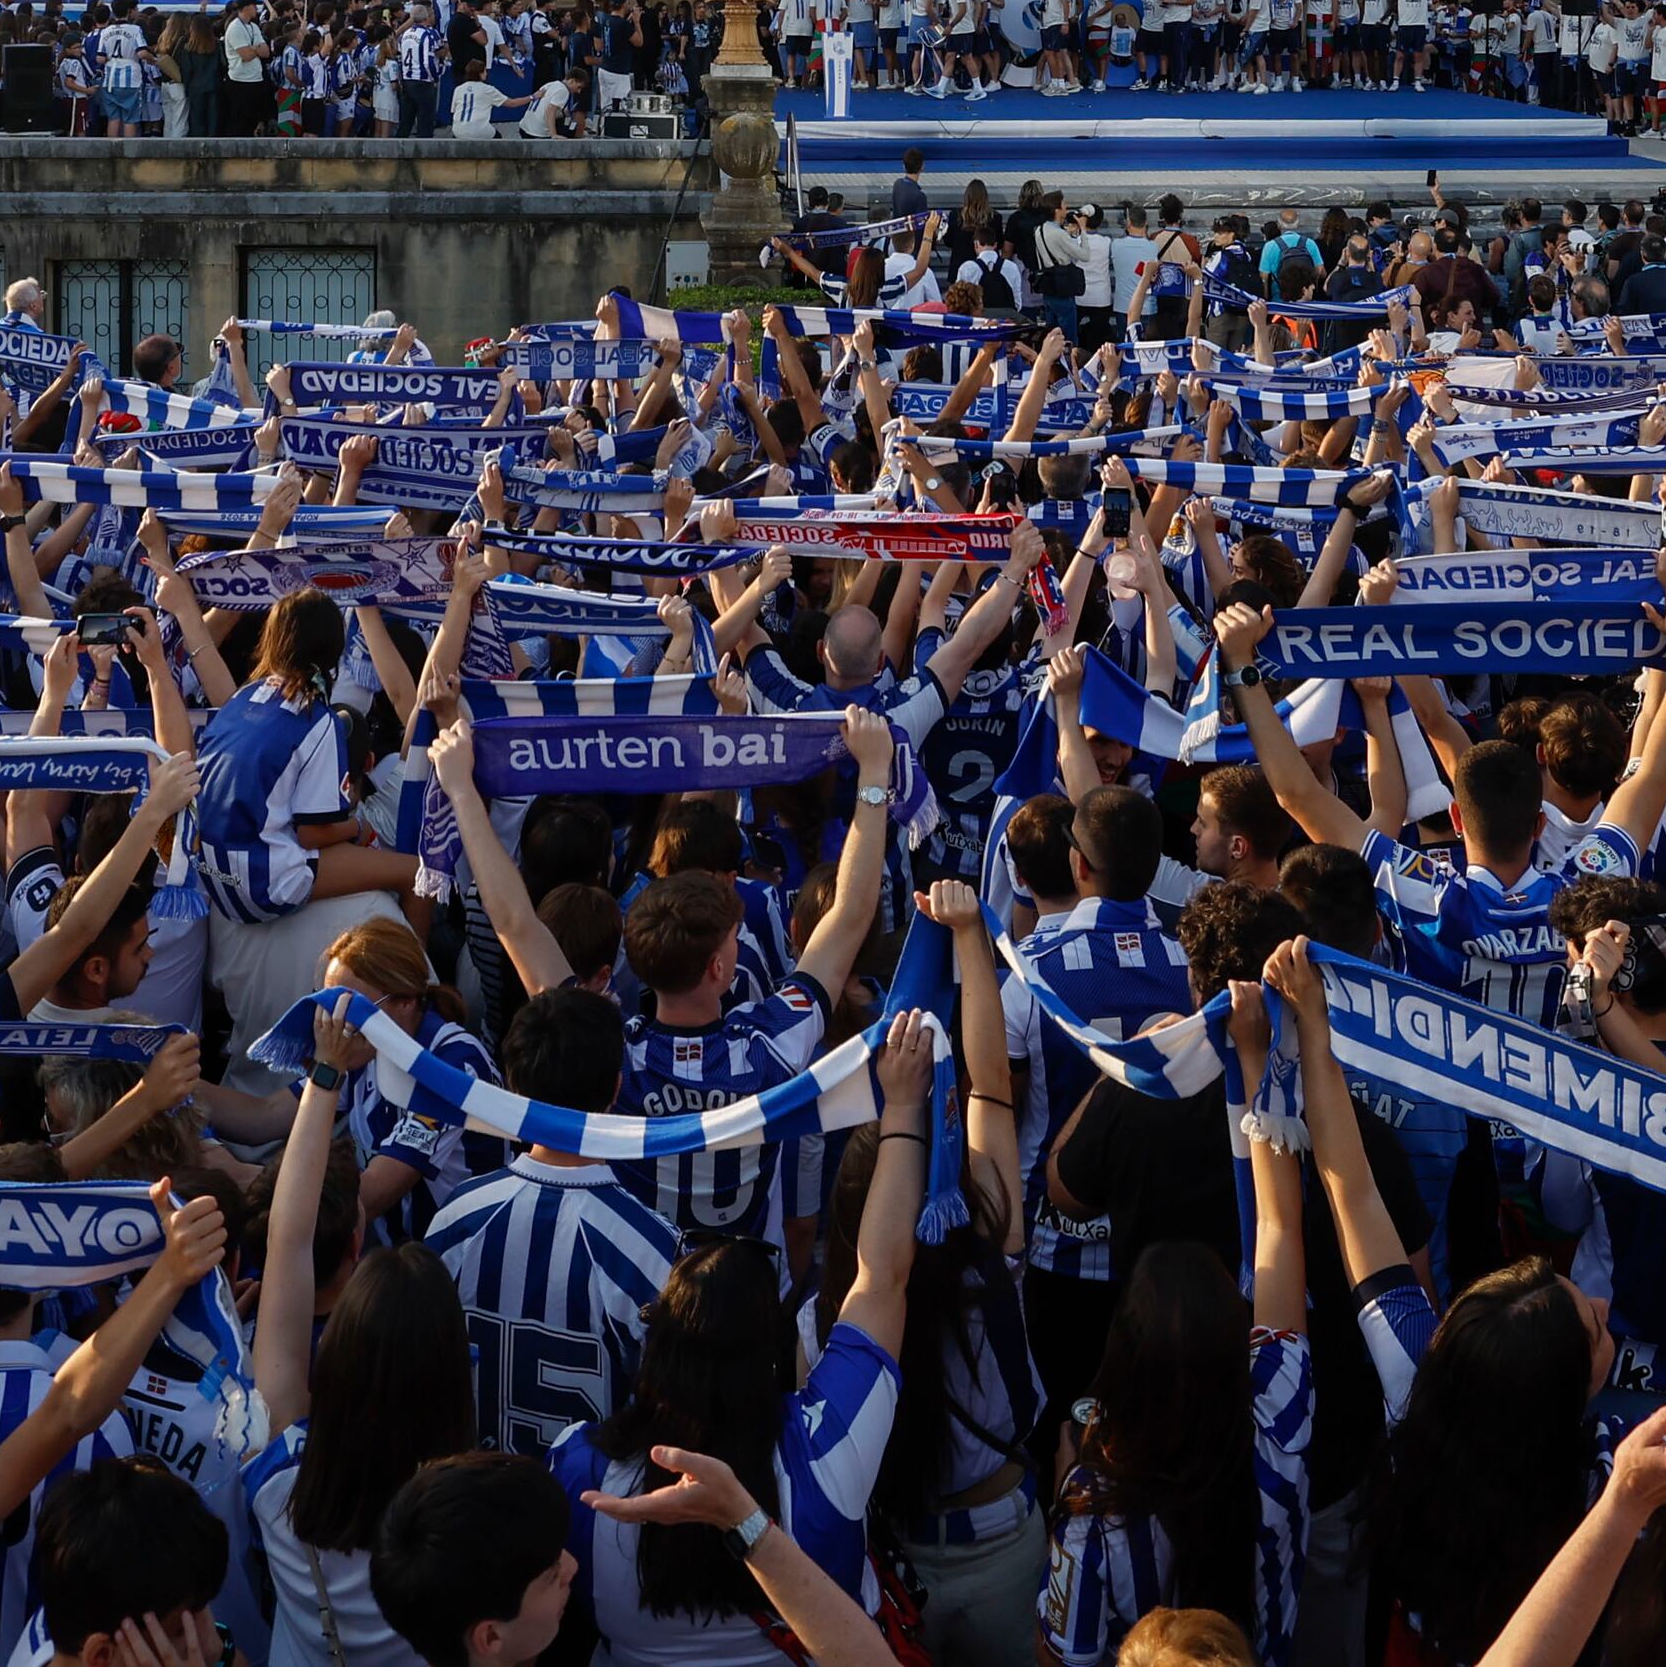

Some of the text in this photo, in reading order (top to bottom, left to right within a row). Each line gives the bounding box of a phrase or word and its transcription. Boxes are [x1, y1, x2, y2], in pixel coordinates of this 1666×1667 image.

[301, 368, 503, 402] EAL SOCIEDAD
[1279, 622, 1440, 663] REAL
[508, 723, 788, 771] aurten bai
[948, 751, 995, 804] 2
